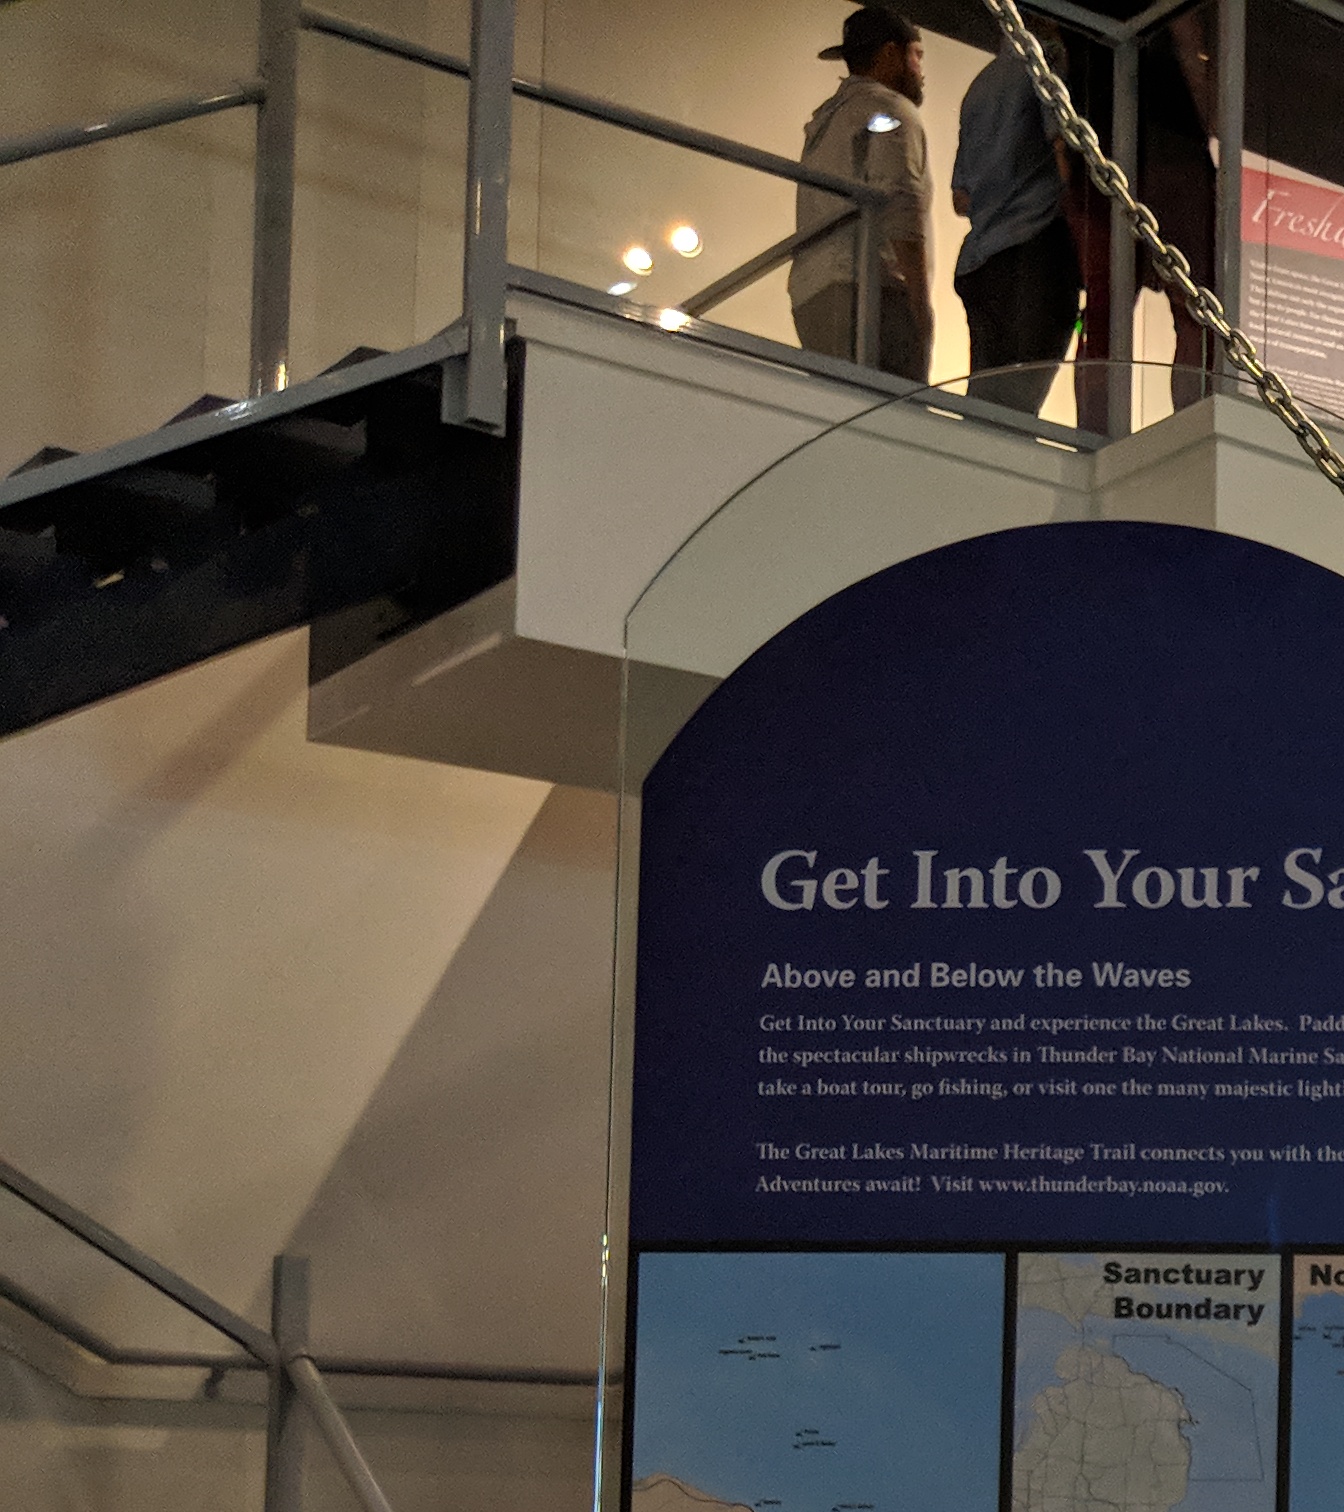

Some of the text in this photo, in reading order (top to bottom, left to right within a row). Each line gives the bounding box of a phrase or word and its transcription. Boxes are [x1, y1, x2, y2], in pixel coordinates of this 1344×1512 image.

[760, 848, 890, 911] Get
[909, 849, 1062, 909] Into
[1082, 848, 1260, 909] Your
[760, 961, 1192, 988] Above and Below the Waves
[758, 1013, 792, 1031] Get
[797, 1014, 836, 1031] Into
[840, 1014, 887, 1031] Your
[889, 1013, 986, 1035] Sanctuary
[989, 1013, 1025, 1030] and
[1029, 1014, 1132, 1035] experience
[1135, 1013, 1167, 1031] the
[1170, 1013, 1224, 1031] Great
[1229, 1013, 1288, 1031] Lakes.
[758, 1045, 788, 1063] the
[792, 1045, 901, 1067] spectacular
[903, 1045, 1008, 1067] shipwrecks
[1012, 1046, 1031, 1063] in
[1036, 1044, 1118, 1063] Thunder
[1122, 1045, 1157, 1067] Bay
[1161, 1045, 1243, 1063] National
[1248, 1046, 1319, 1064] Marine
[757, 1077, 798, 1095] take
[800, 1082, 812, 1095] a
[816, 1077, 857, 1095] boat
[861, 1080, 907, 1097] tour,
[910, 1082, 934, 1100] go
[937, 1077, 1008, 1100] fishing,
[1012, 1082, 1034, 1095] or
[1038, 1078, 1078, 1095] visit
[1121, 1077, 1153, 1095] the
[1157, 1083, 1210, 1100] many
[1214, 1079, 1293, 1099] majestic
[754, 1142, 790, 1160] The
[794, 1142, 846, 1160] Great
[851, 1142, 904, 1160] Lakes
[909, 1142, 998, 1160] Maritime
[1002, 1142, 1085, 1164] Heritage
[1088, 1142, 1136, 1160] Trail
[1138, 1146, 1225, 1161] connects
[1229, 1148, 1264, 1166] you
[1268, 1143, 1311, 1162] with
[754, 1174, 1230, 1198] Adventures await! Visit www.thunderbay.noaa.gov.
[1102, 1261, 1266, 1292] Sanctuary
[1113, 1296, 1265, 1326] Boundary
